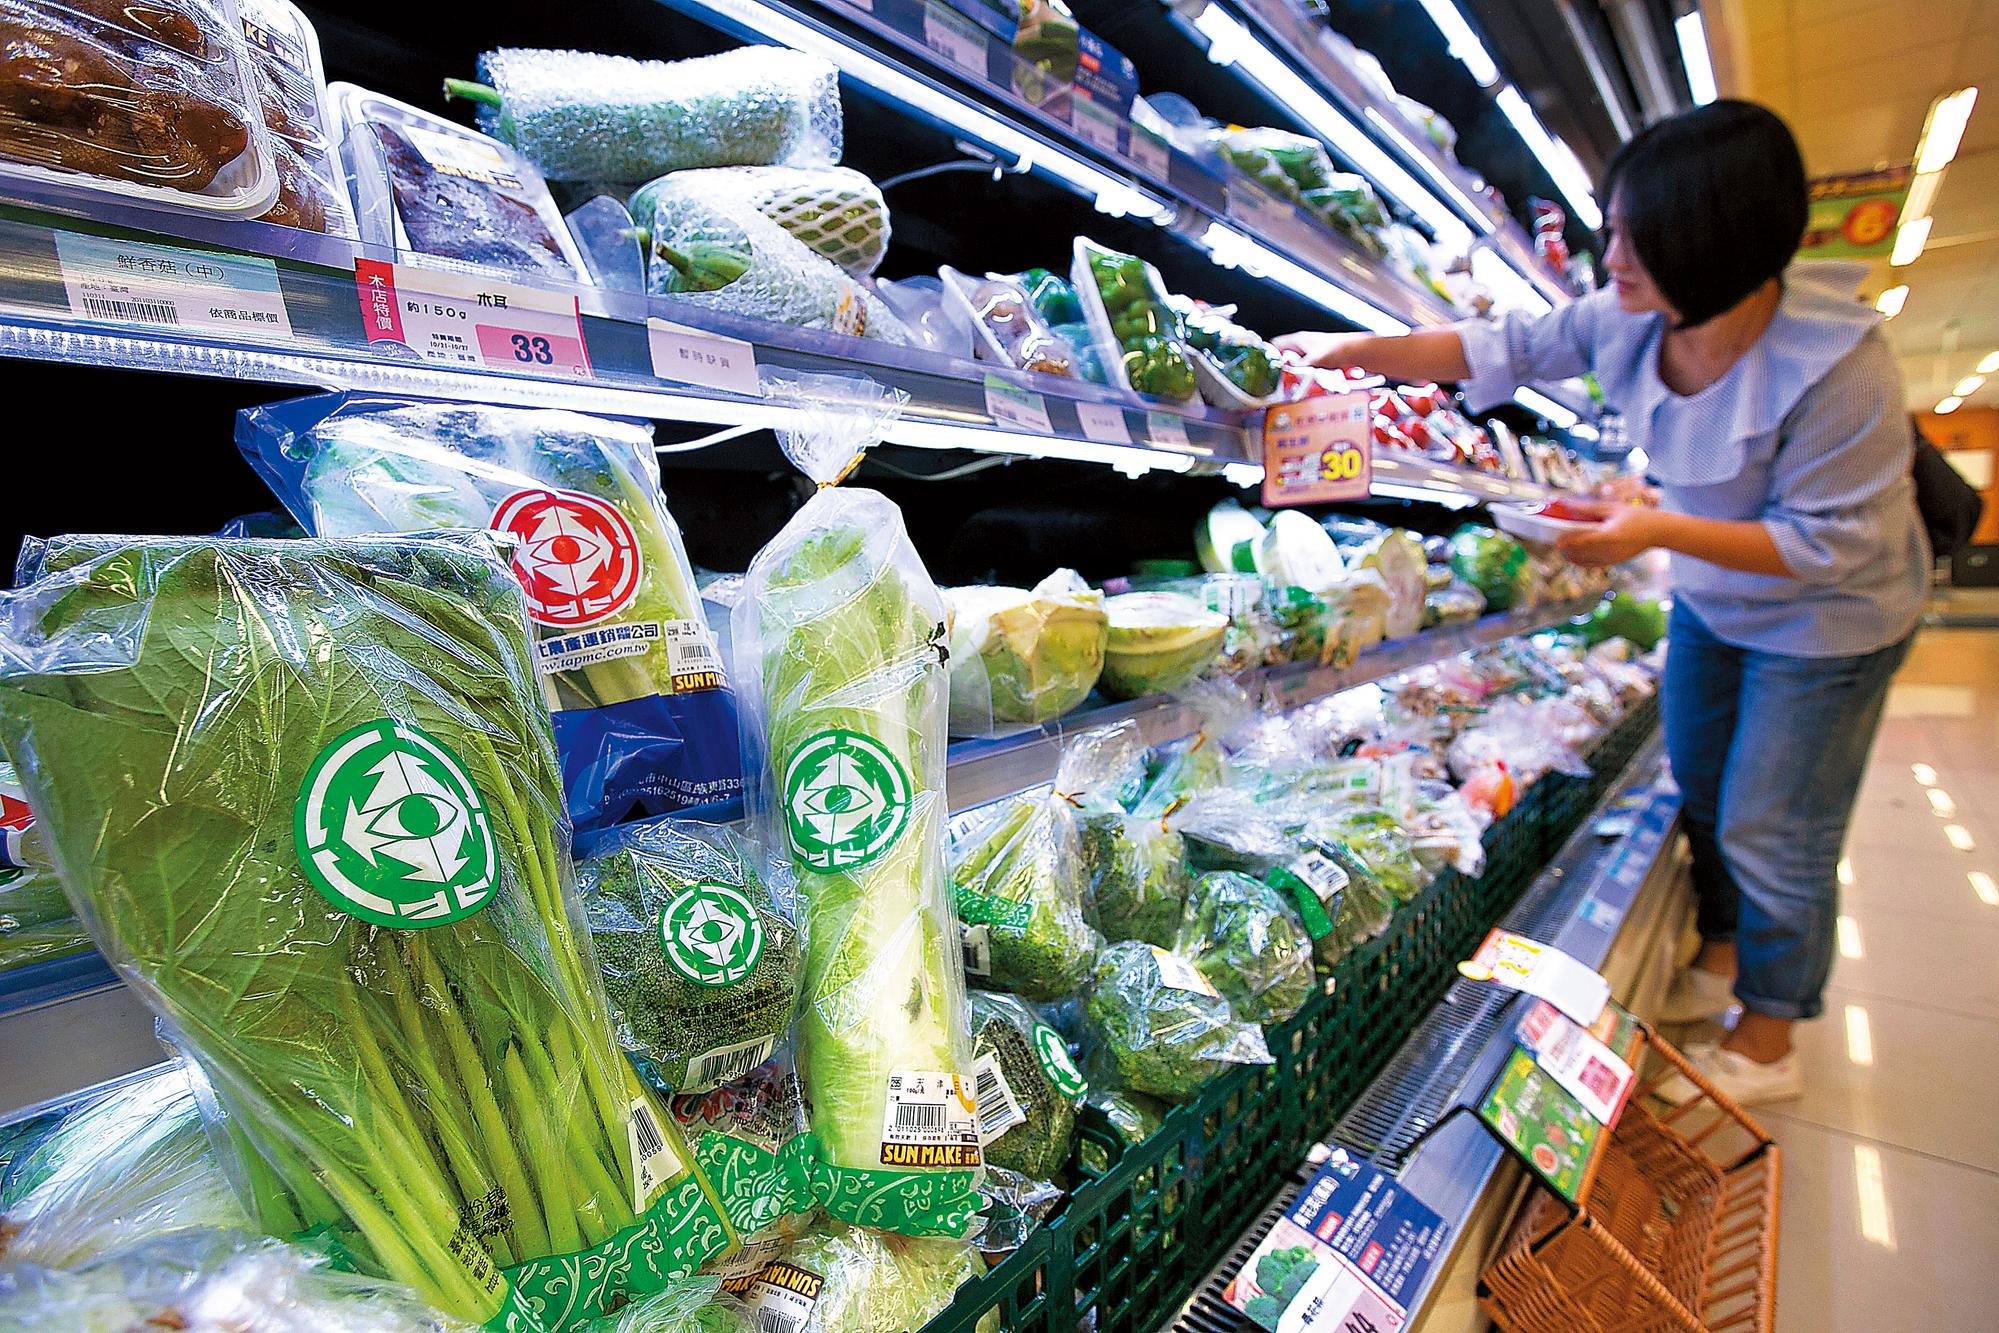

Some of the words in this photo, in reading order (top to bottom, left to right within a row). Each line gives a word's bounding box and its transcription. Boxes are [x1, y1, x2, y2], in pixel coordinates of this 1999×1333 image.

[477, 292, 508, 310] 木耳
[209, 307, 280, 324] 依商品標價
[511, 334, 554, 365] 33
[1322, 448, 1361, 480] 30
[675, 673, 705, 690] SUN
[883, 1144, 919, 1164] SUN
[920, 1145, 962, 1165] MAKE
[787, 1270, 821, 1297] SUN
